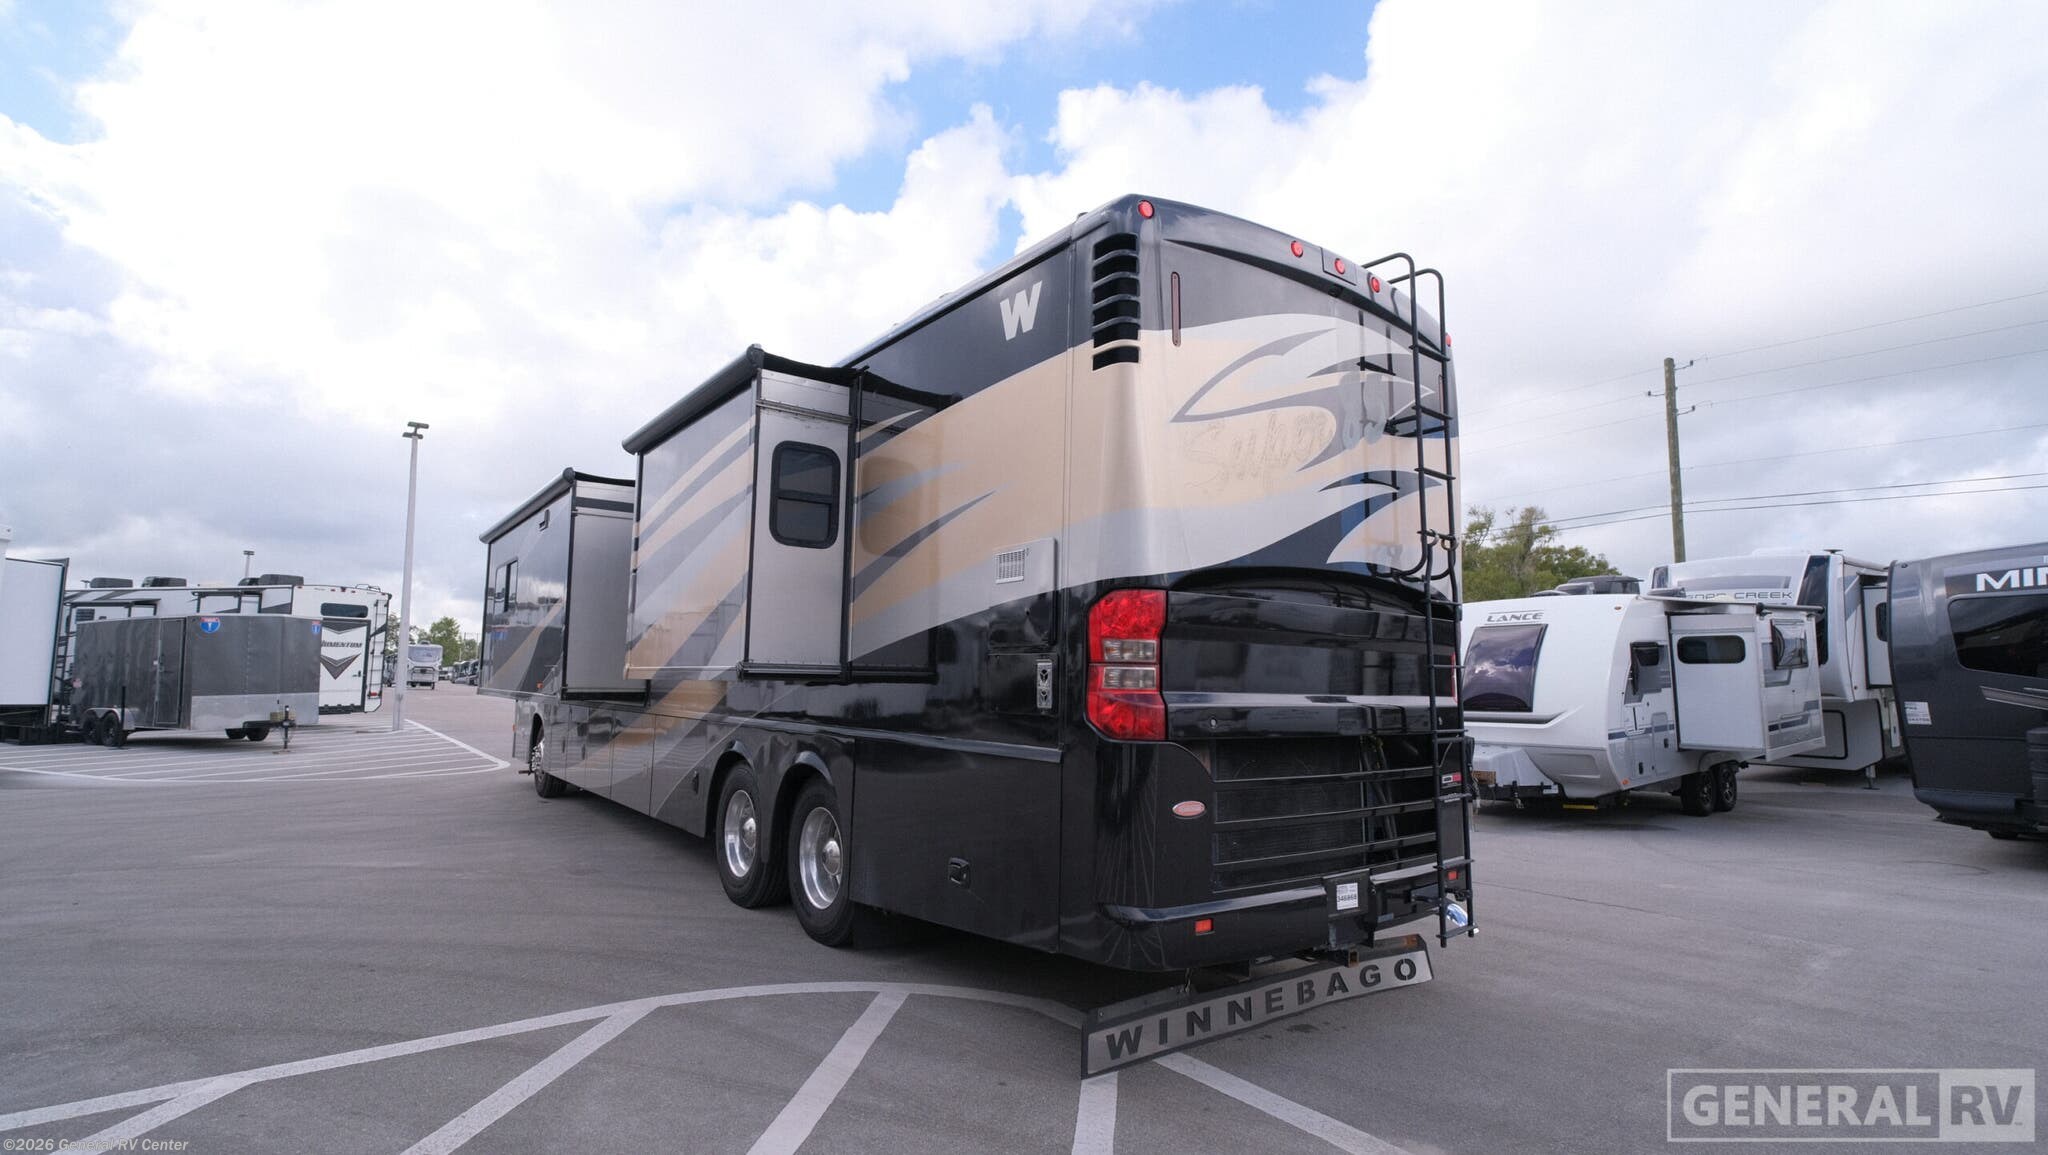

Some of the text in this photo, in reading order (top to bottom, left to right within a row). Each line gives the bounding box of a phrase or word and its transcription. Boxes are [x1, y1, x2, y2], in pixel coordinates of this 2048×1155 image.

[1000, 280, 1042, 341] W
[1734, 591, 1792, 600] CREEK
[1487, 612, 1544, 622] LANCE
[1105, 958, 1417, 1060] WINNEBAGO
